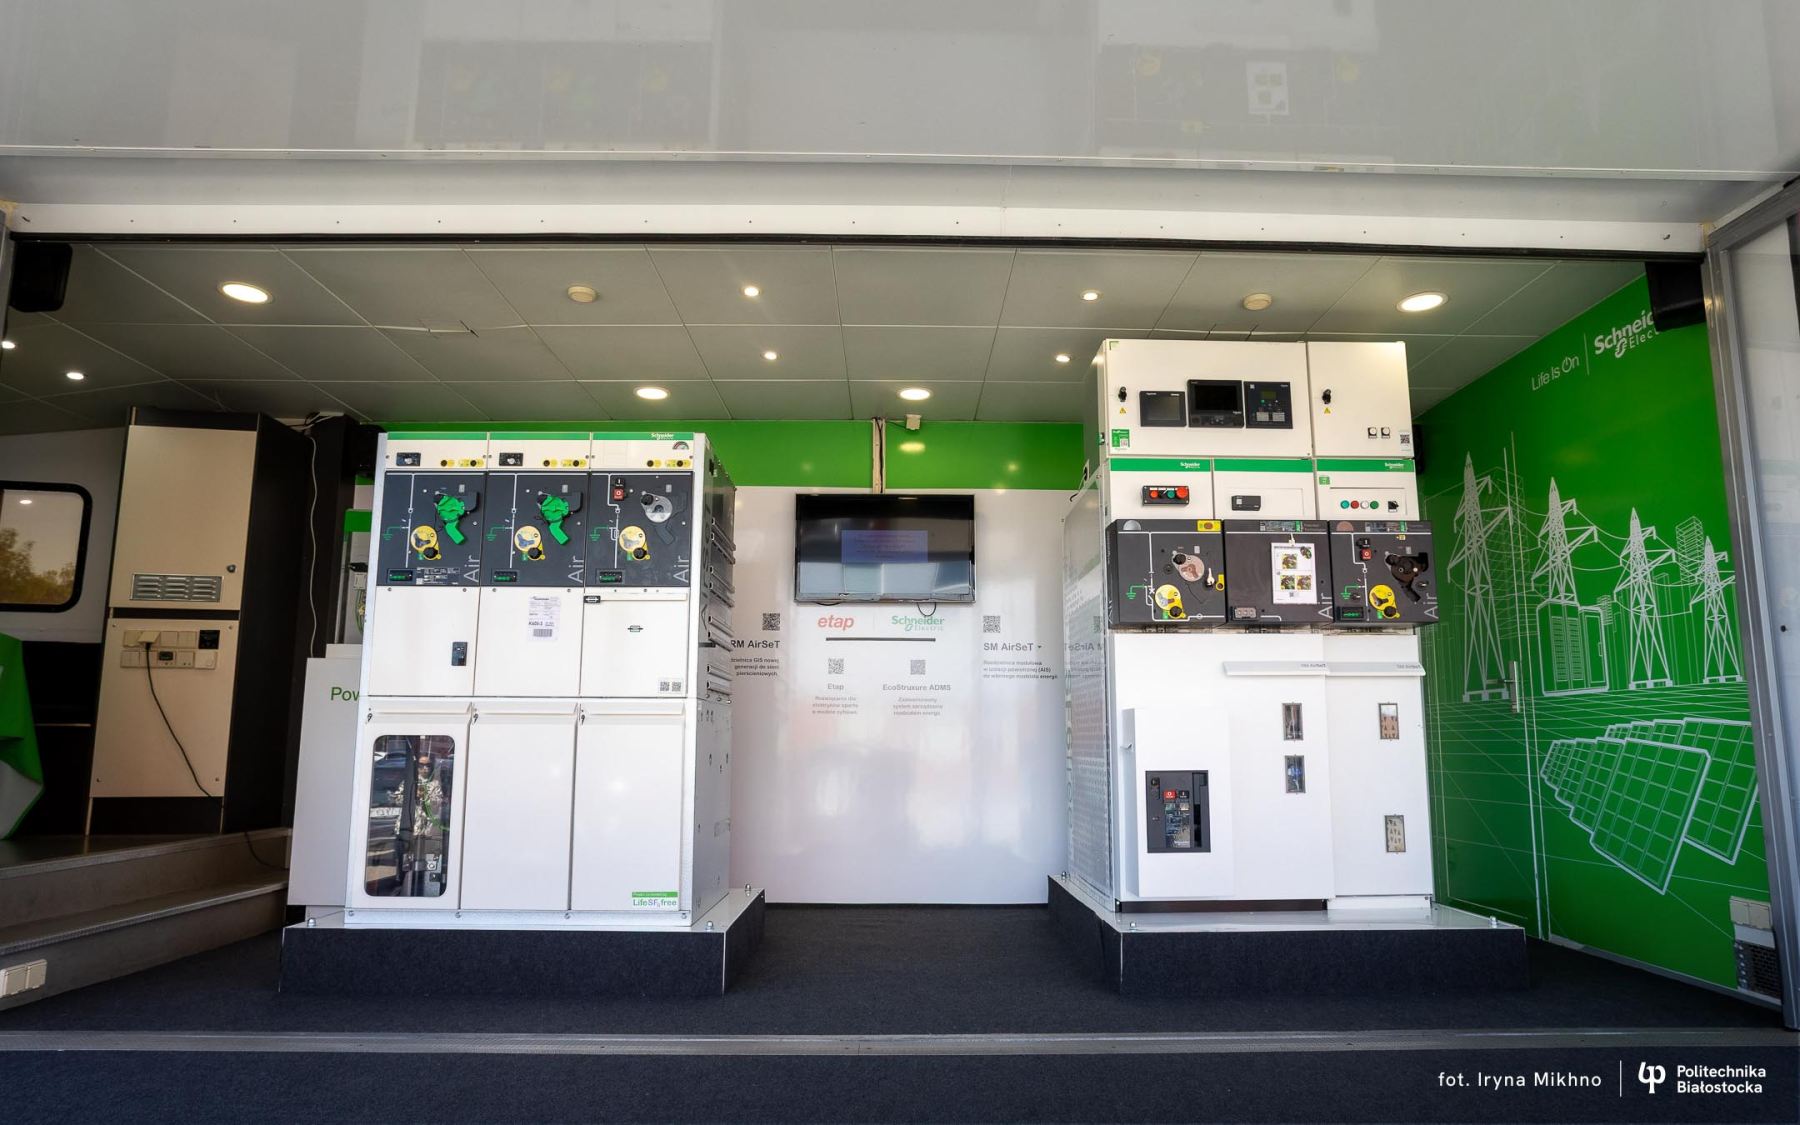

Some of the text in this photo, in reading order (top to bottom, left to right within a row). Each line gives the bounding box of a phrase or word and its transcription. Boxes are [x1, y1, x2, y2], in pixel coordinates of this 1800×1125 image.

[1531, 356, 1580, 391] Life Is On
[464, 555, 480, 583] Air
[568, 555, 584, 583] Air
[673, 555, 690, 583] Air
[1318, 592, 1335, 620] Air
[1424, 593, 1439, 619] Air
[817, 614, 855, 631] etap
[891, 615, 944, 625] Schneider
[747, 640, 781, 649] AirSeT
[983, 643, 1034, 652] SM AirSeT
[827, 683, 844, 692] Etap
